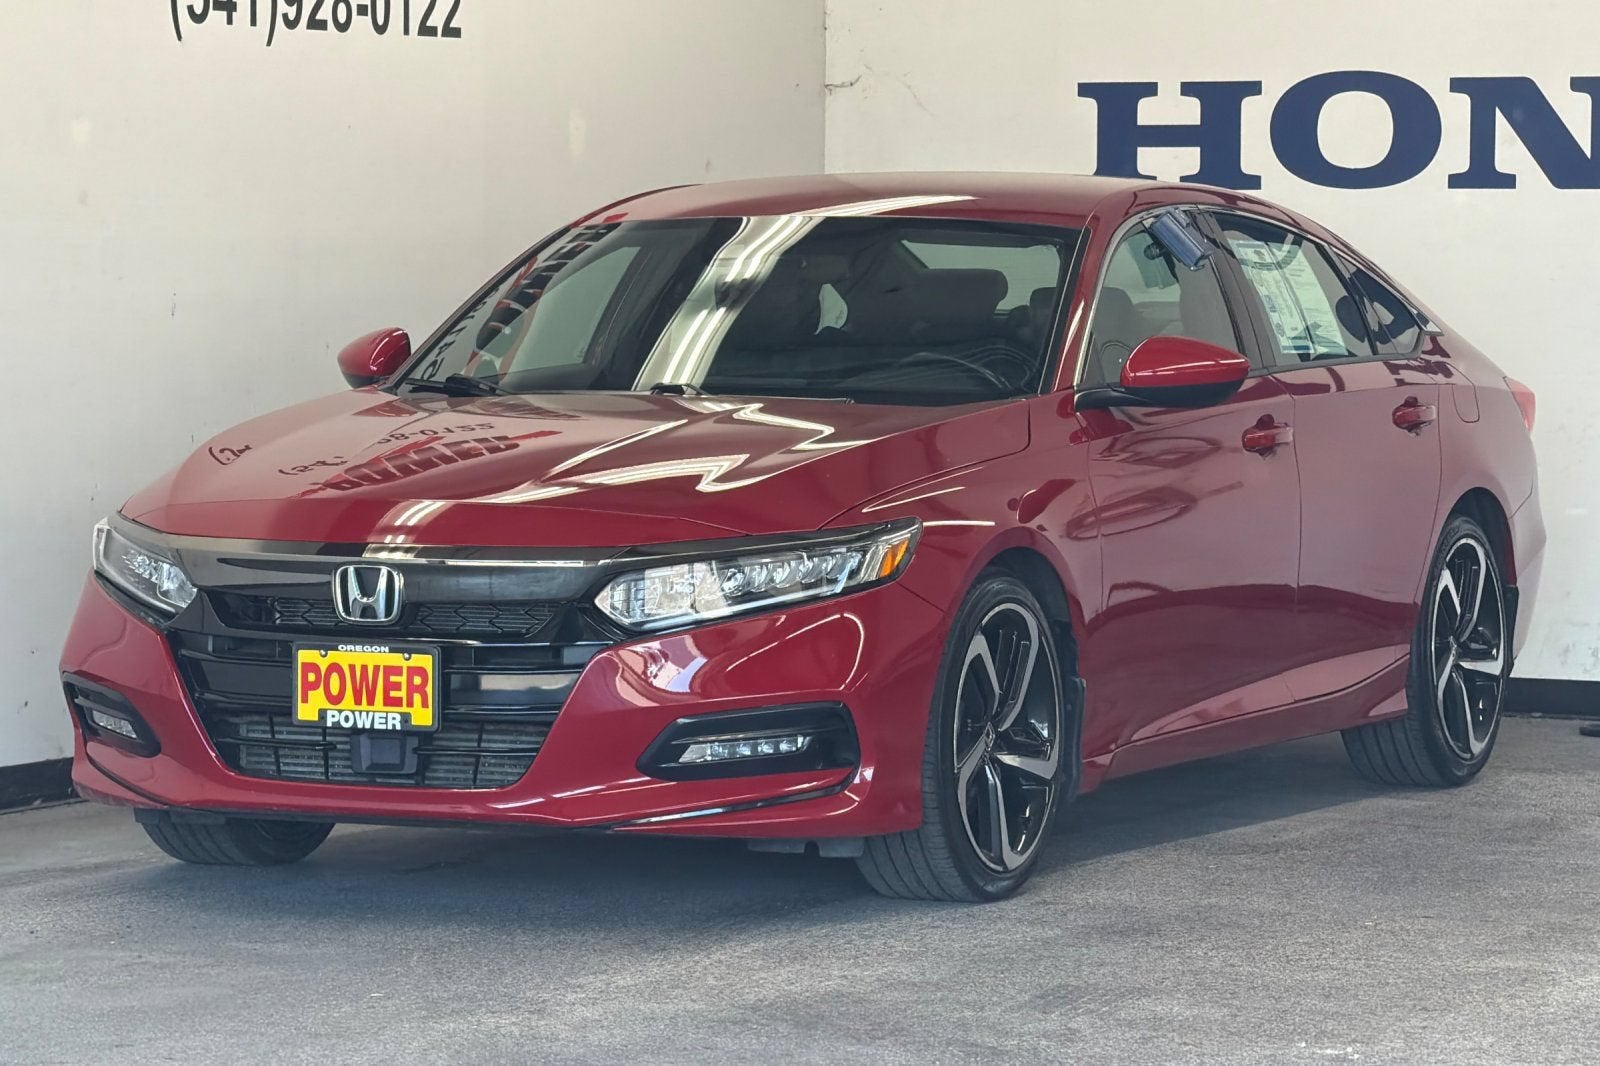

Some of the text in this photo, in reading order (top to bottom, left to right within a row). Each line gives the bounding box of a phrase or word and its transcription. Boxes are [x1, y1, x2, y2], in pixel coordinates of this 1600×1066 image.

[1077, 70, 1600, 191] HON
[338, 644, 390, 653] OREGON
[301, 662, 429, 708] POWER
[326, 709, 401, 730] POWER
